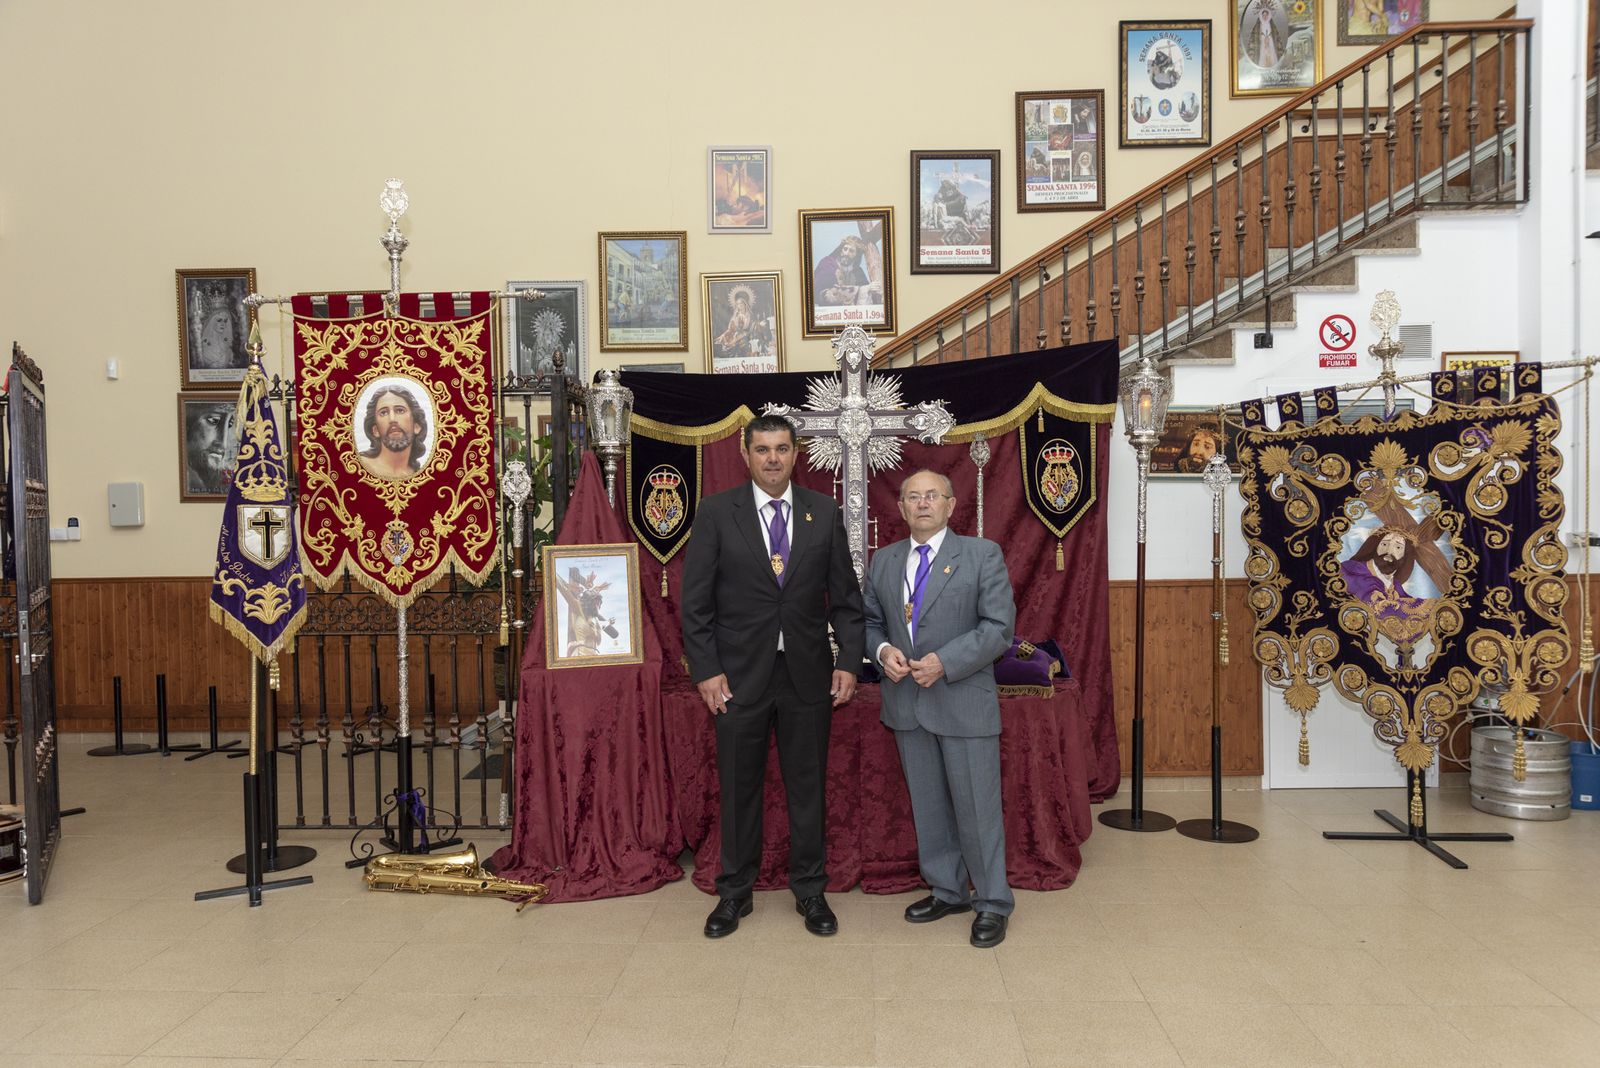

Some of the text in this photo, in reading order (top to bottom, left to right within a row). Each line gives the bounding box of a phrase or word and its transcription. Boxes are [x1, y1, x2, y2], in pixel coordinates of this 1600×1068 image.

[1139, 36, 1158, 62] SEMANA
[1159, 32, 1182, 43] SANTA
[1027, 182, 1096, 192] SEMANA SANTA 1996
[955, 248, 980, 256] Santa
[815, 311, 841, 321] Semana
[843, 309, 863, 320] Santa
[714, 364, 740, 374] Semana
[742, 360, 760, 373] Santa
[228, 561, 255, 584] Padre
